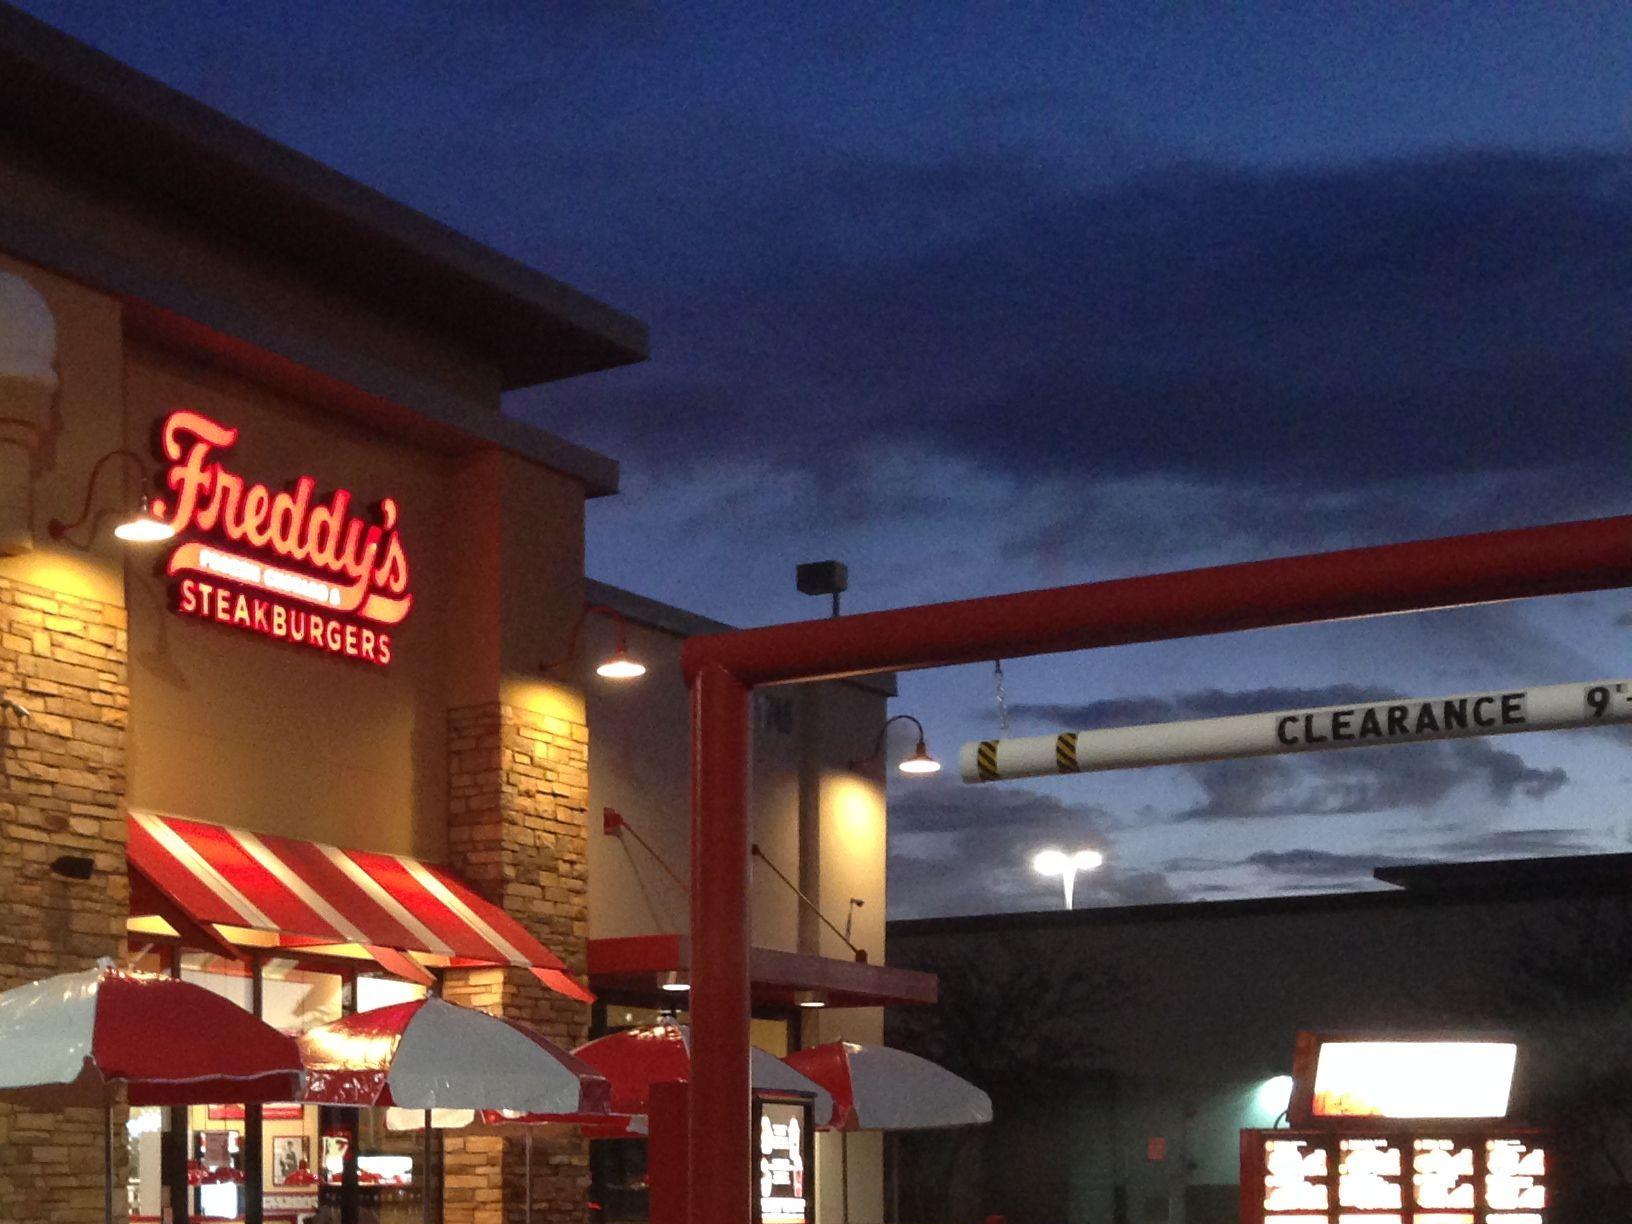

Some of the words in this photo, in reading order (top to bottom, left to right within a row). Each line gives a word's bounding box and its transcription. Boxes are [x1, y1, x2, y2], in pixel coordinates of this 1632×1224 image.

[154, 409, 409, 594] Freddy's
[181, 579, 392, 666] STEAKBURGERS
[1275, 691, 1528, 747] CLEARANCE
